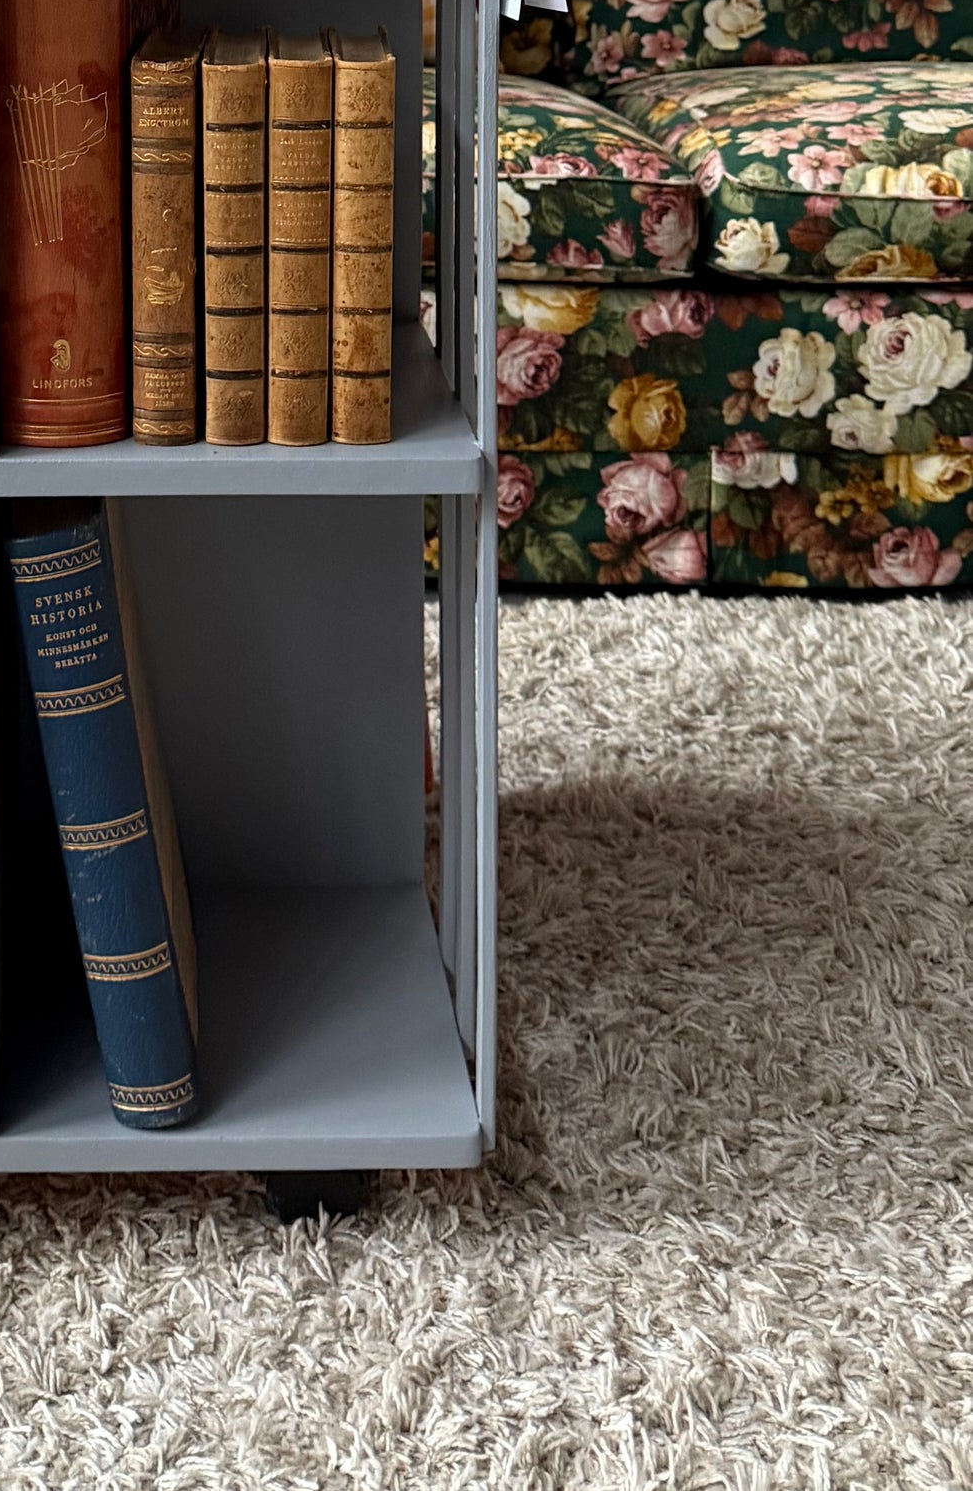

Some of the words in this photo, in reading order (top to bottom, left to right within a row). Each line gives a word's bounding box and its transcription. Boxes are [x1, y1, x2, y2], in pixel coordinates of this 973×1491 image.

[142, 107, 185, 116] ALBERT
[36, 586, 92, 607] SVENSK
[31, 600, 102, 625] HISTORIA
[46, 630, 76, 642] KONST
